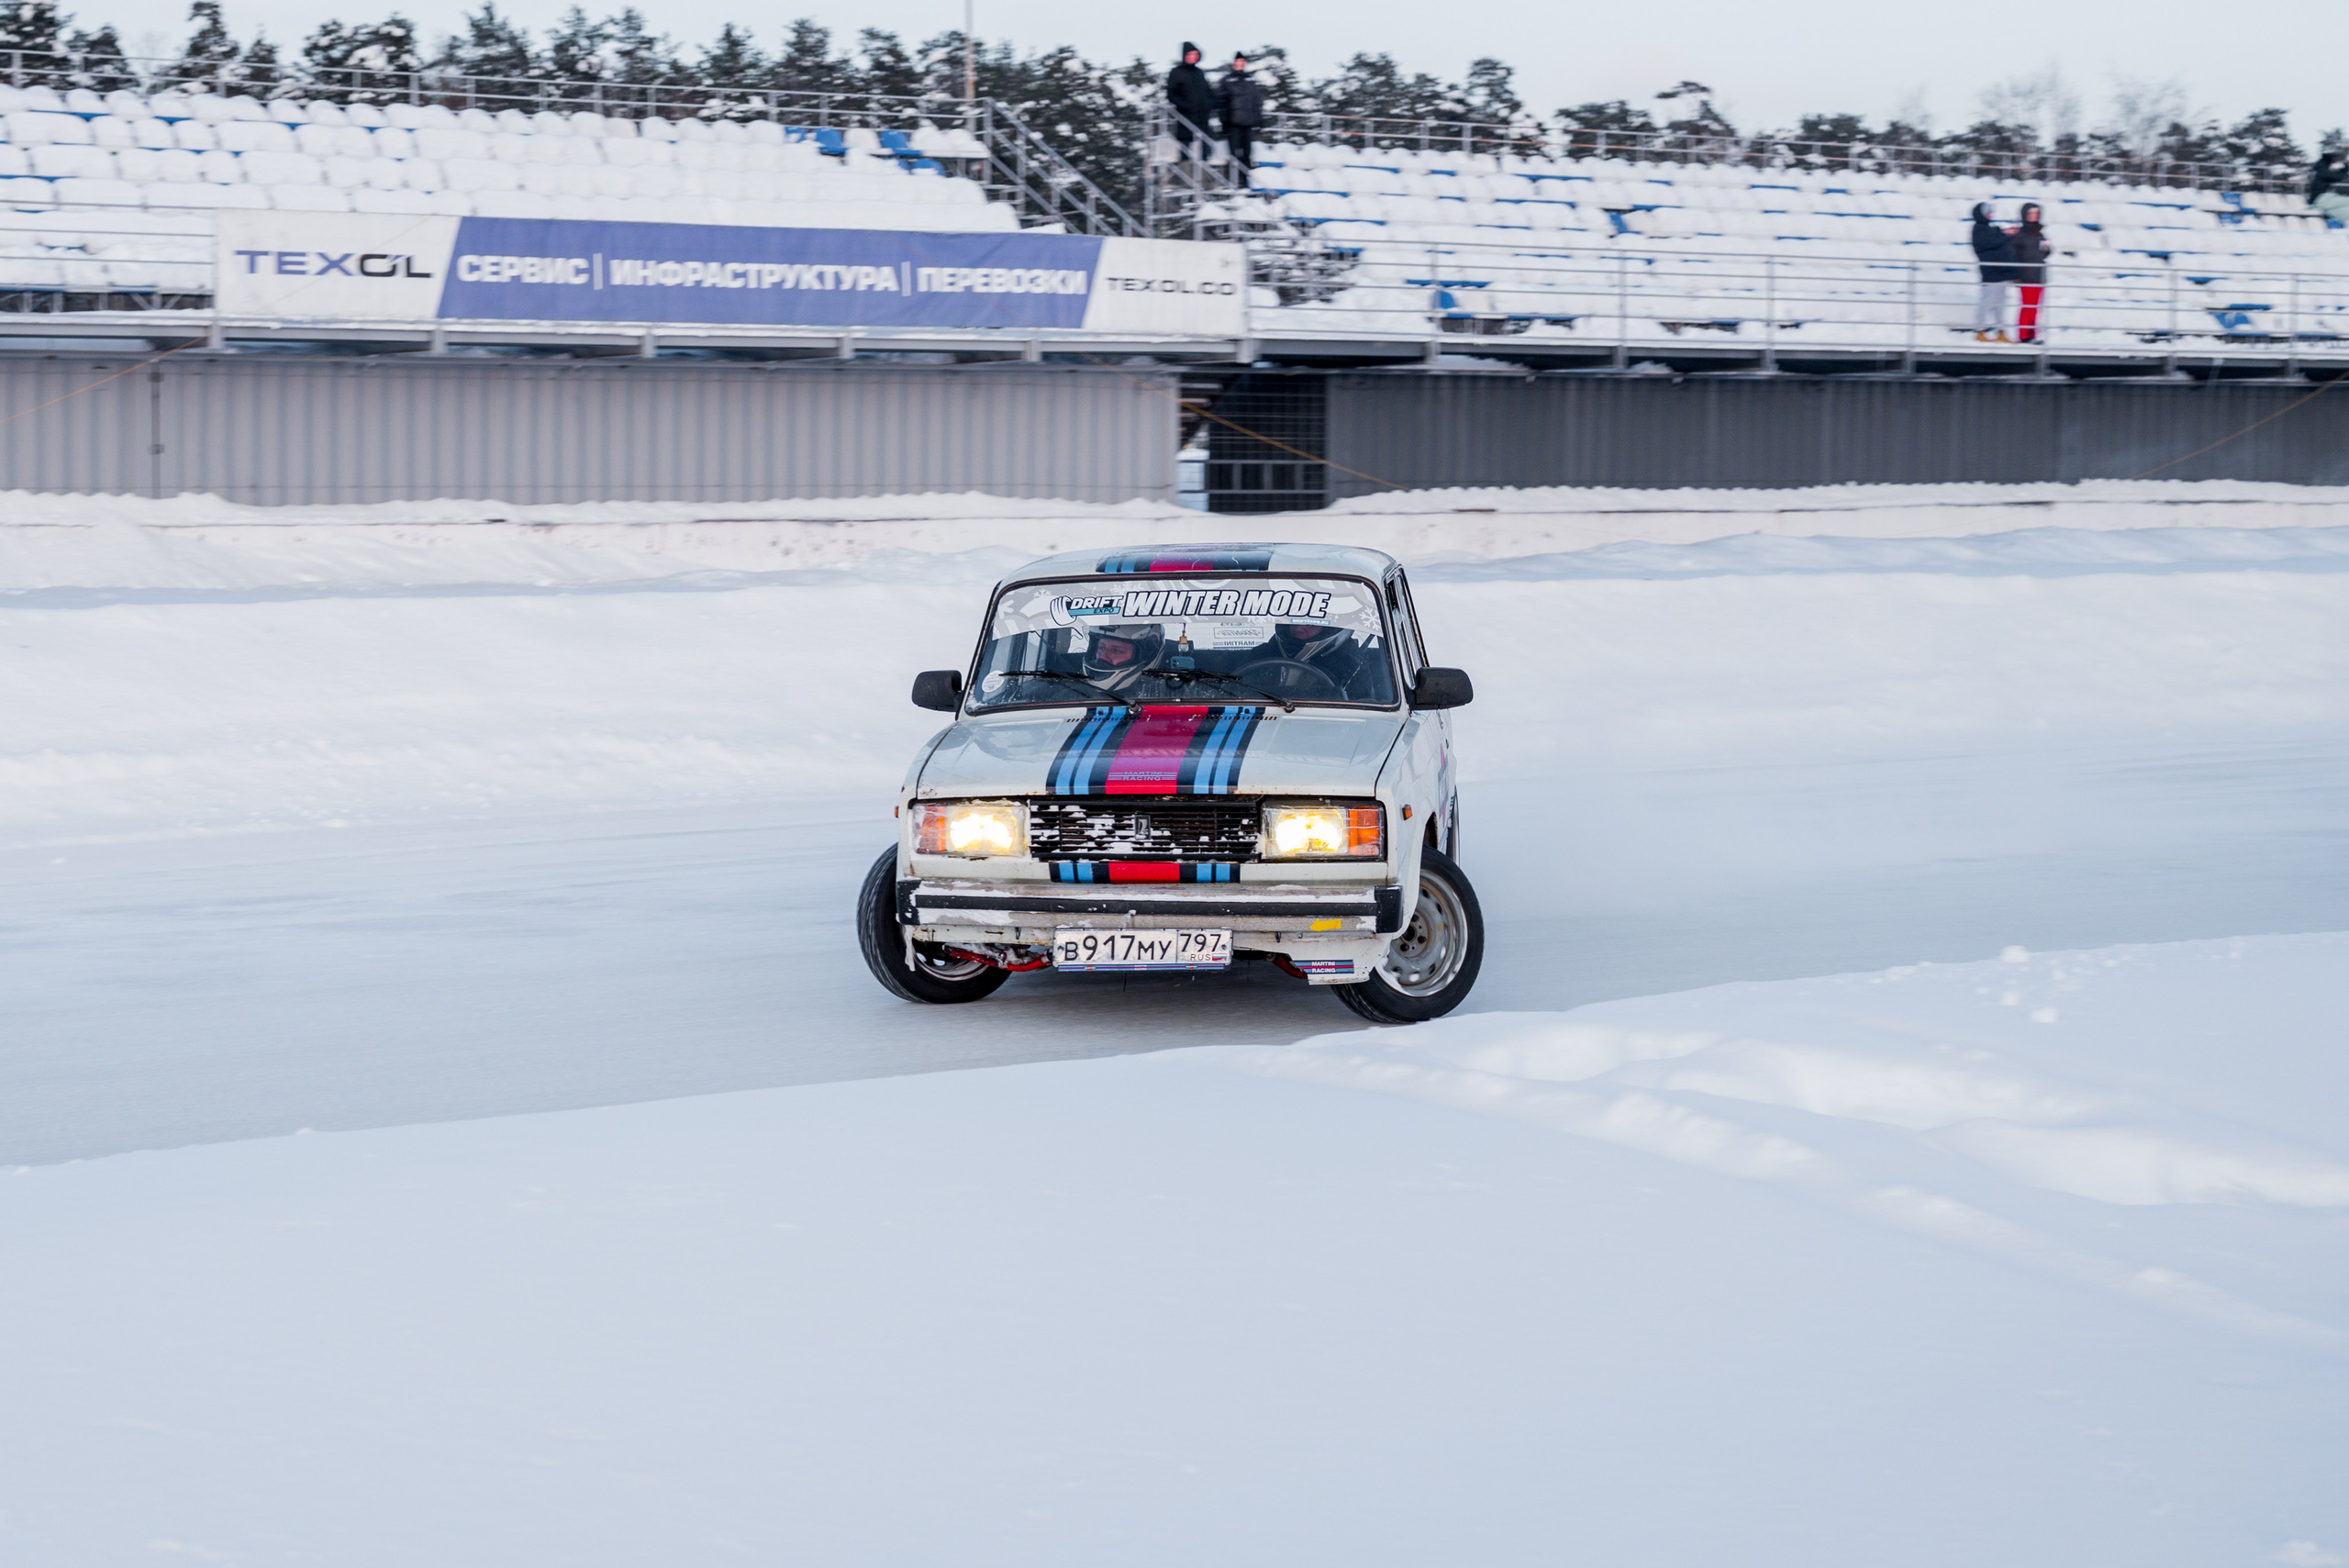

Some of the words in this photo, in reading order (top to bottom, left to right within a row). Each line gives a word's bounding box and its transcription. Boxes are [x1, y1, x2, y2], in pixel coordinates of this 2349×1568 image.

[234, 249, 432, 279] TEXOL
[457, 253, 589, 285] СЕРВИС
[609, 258, 899, 292] ИНФРАСТРУКТУРА
[918, 266, 1087, 296] ПЕРЕВОЗКИ
[1107, 276, 1238, 296] TEXOL.CO
[1069, 595, 1124, 609] DRIFT
[1122, 589, 1242, 617] WINTER
[1241, 589, 1331, 618] MODE
[1180, 933, 1222, 952] 797
